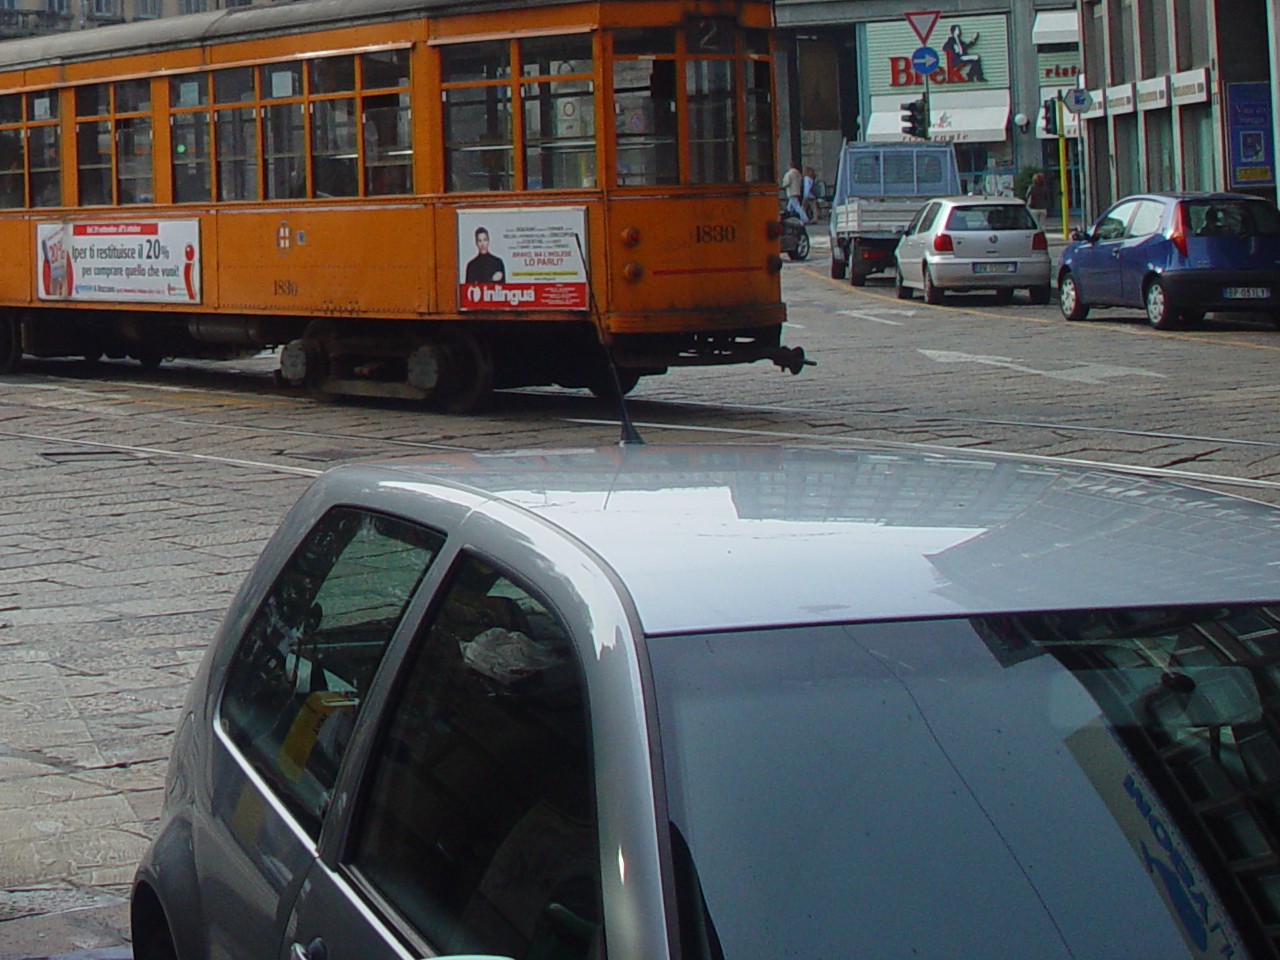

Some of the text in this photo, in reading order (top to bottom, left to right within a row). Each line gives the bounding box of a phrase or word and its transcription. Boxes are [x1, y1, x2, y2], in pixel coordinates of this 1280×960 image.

[902, 131, 969, 142] ristrante
[696, 225, 735, 243] 1830
[71, 238, 170, 263] Iper ti restituisce il 20%
[524, 257, 564, 267] LO PARLI?
[81, 264, 180, 279] per comprare quello che vuoi!
[483, 285, 535, 306] inlingua
